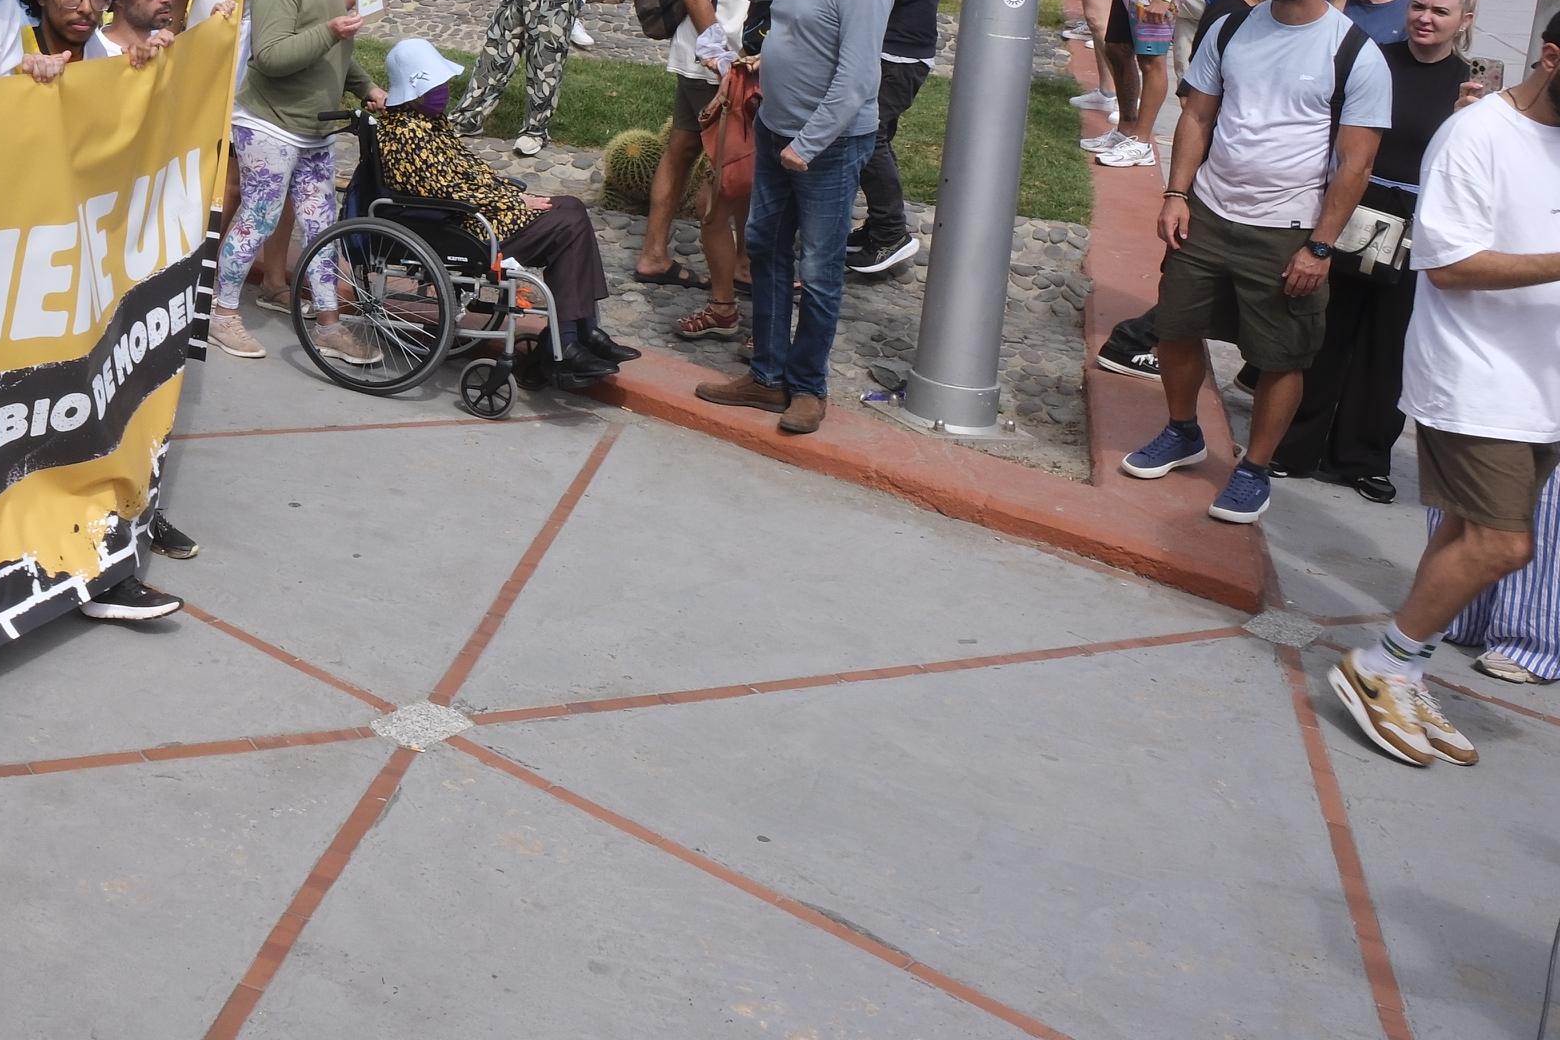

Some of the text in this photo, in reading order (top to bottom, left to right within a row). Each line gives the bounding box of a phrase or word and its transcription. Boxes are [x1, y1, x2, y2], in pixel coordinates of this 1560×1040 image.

[124, 148, 202, 281] UN
[92, 355, 116, 420] DE
[114, 273, 201, 385] MODEL
